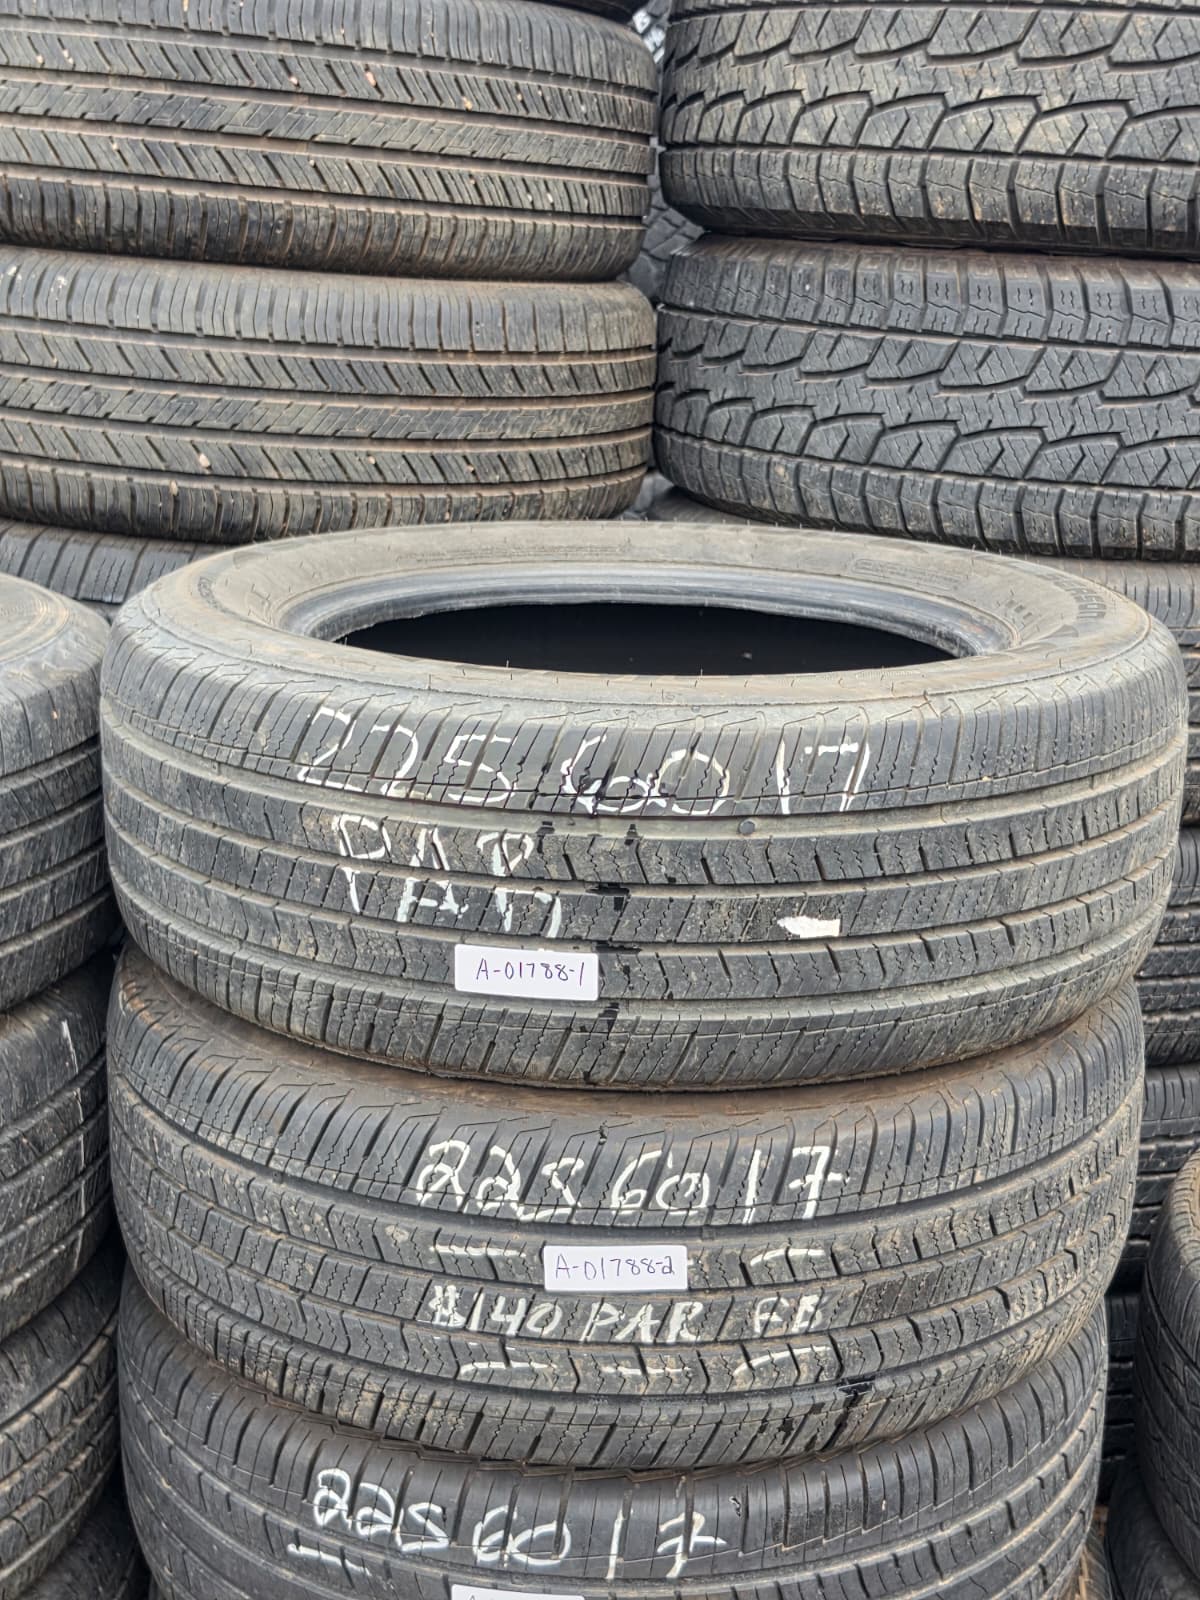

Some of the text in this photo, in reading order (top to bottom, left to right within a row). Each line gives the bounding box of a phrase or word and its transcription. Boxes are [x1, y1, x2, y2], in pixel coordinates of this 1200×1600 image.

[296, 705, 871, 816] 225 60 17
[475, 956, 586, 988] A-01788-1
[609, 1149, 713, 1217] 60
[742, 1145, 852, 1226] 17
[472, 1504, 573, 1567] 60
[604, 1509, 729, 1581] 17
